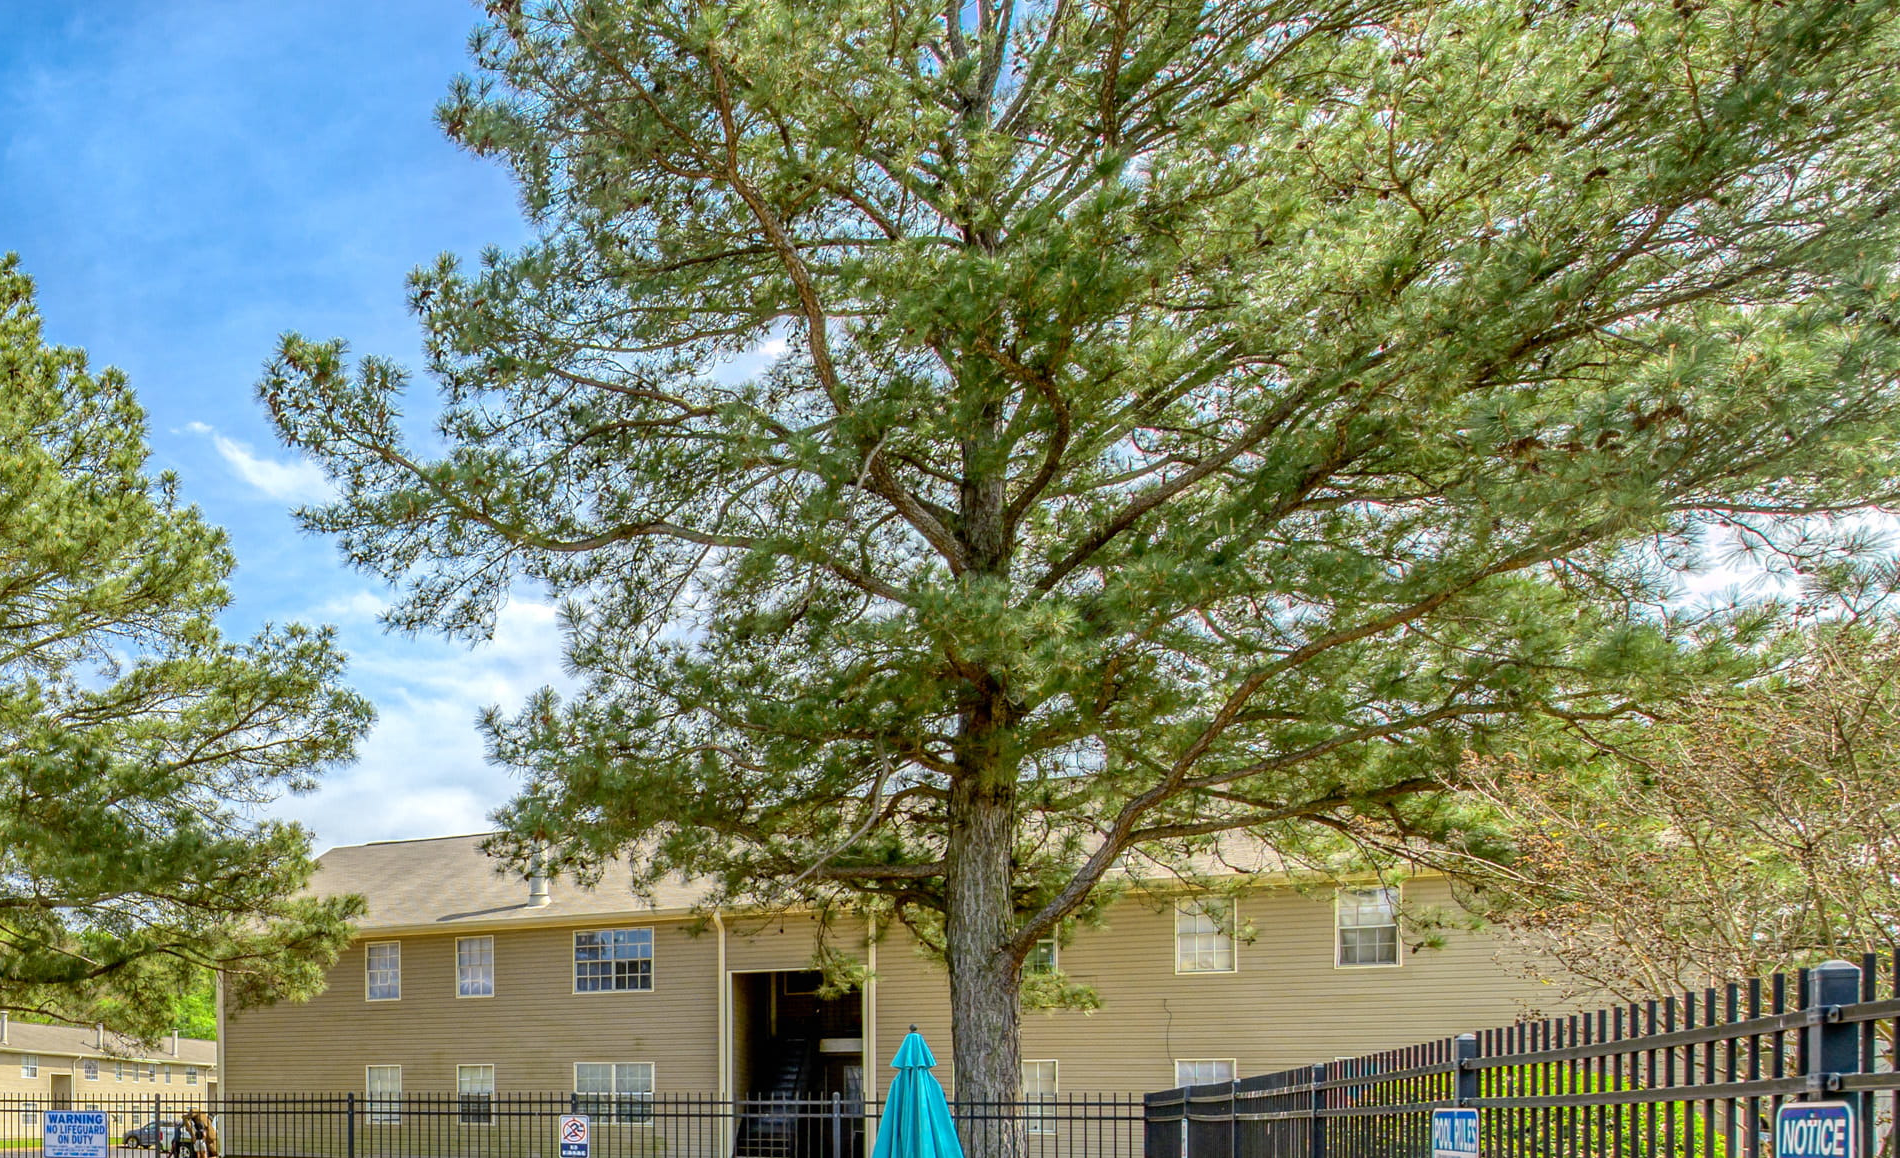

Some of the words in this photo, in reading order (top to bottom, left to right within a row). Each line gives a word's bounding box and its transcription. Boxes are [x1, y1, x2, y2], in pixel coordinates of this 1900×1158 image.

[48, 1114, 103, 1124] WARNING
[46, 1125, 58, 1134] NO
[60, 1125, 105, 1135] LIFEGUARD
[1434, 1117, 1453, 1150] POOL
[1454, 1118, 1477, 1153] RULES
[57, 1134, 69, 1144] ON
[71, 1135, 94, 1145] DUTY
[1781, 1118, 1846, 1156] NOTICE
